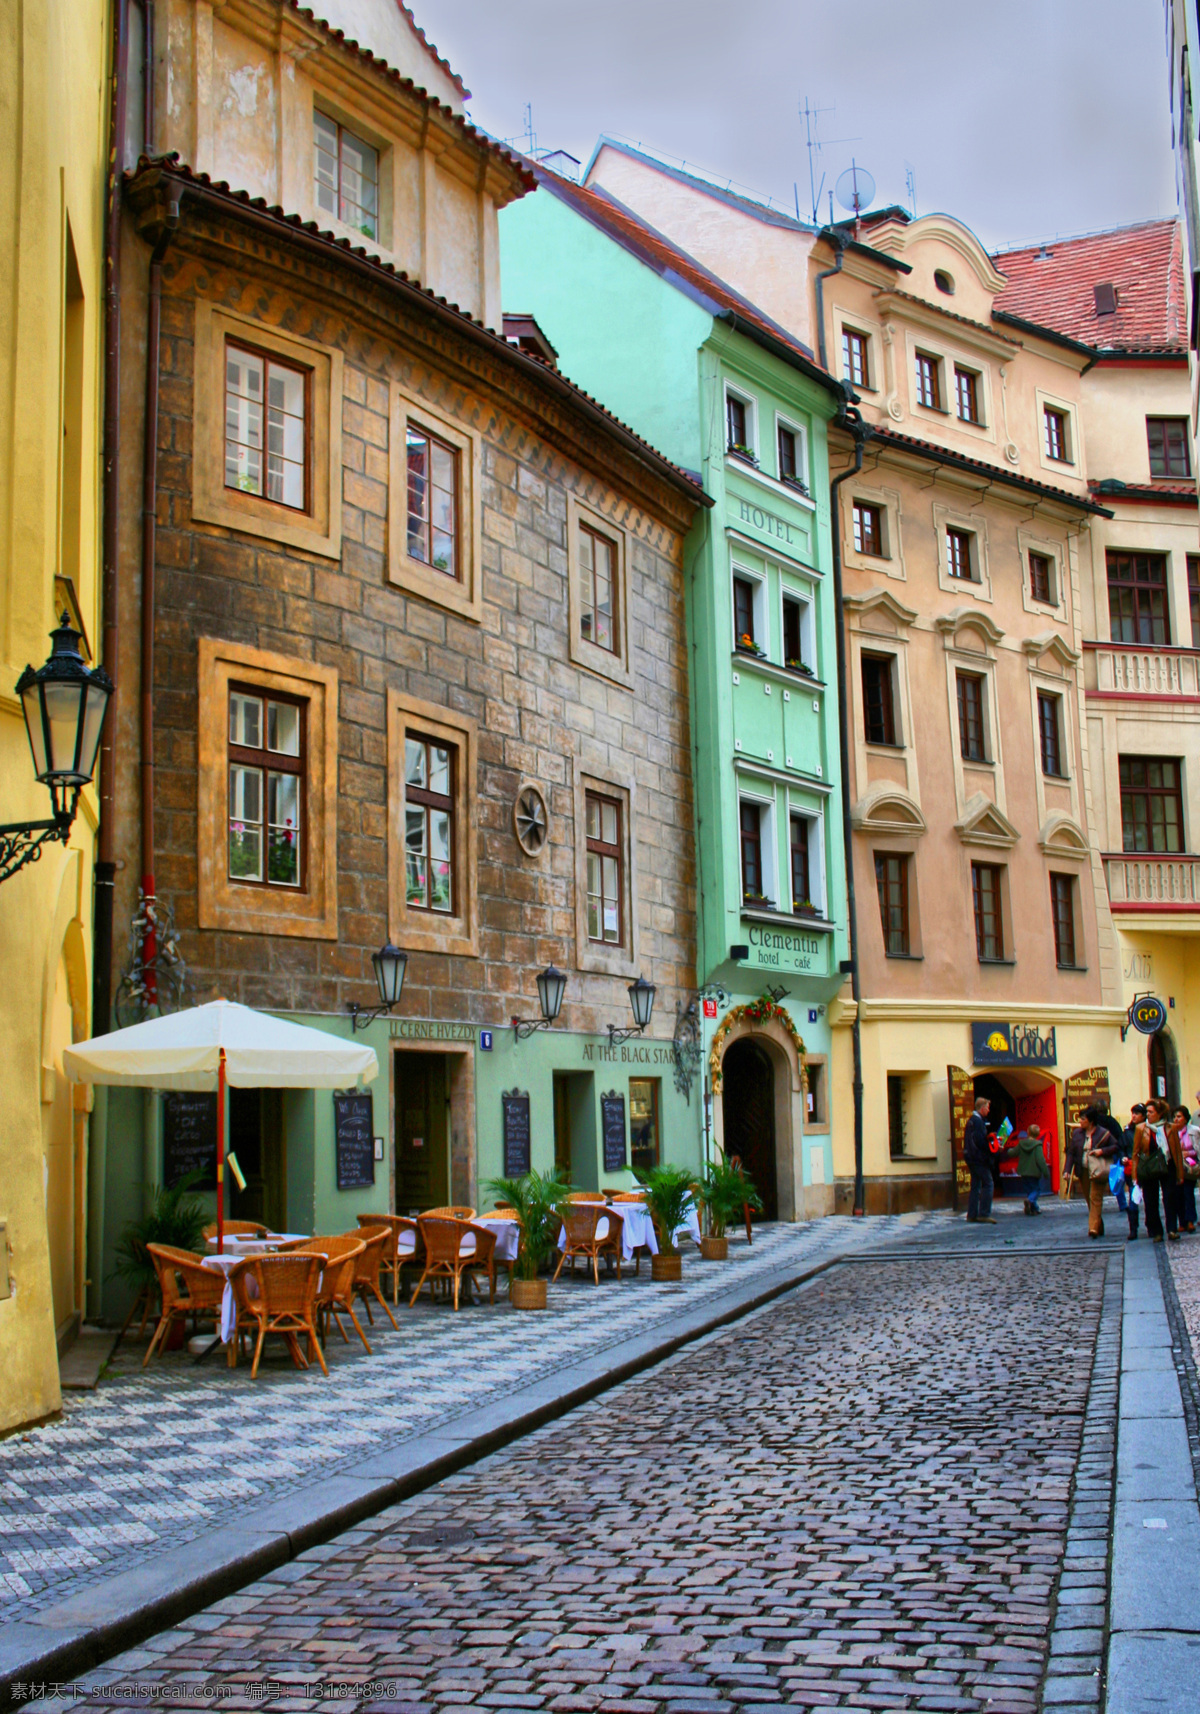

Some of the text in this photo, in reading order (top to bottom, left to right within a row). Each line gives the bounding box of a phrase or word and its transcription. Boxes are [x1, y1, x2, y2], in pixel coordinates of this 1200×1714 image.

[740, 500, 794, 545] HOTEL
[748, 926, 819, 955] Clementin
[757, 950, 780, 966] hotel
[794, 956, 811, 969] café
[389, 1021, 398, 1037] U
[1023, 1022, 1040, 1038] fast
[484, 1034, 490, 1047] 6
[1009, 1024, 1057, 1059] food
[582, 1043, 595, 1061] AT
[597, 1045, 618, 1062] THE
[621, 1046, 651, 1064] BLACK
